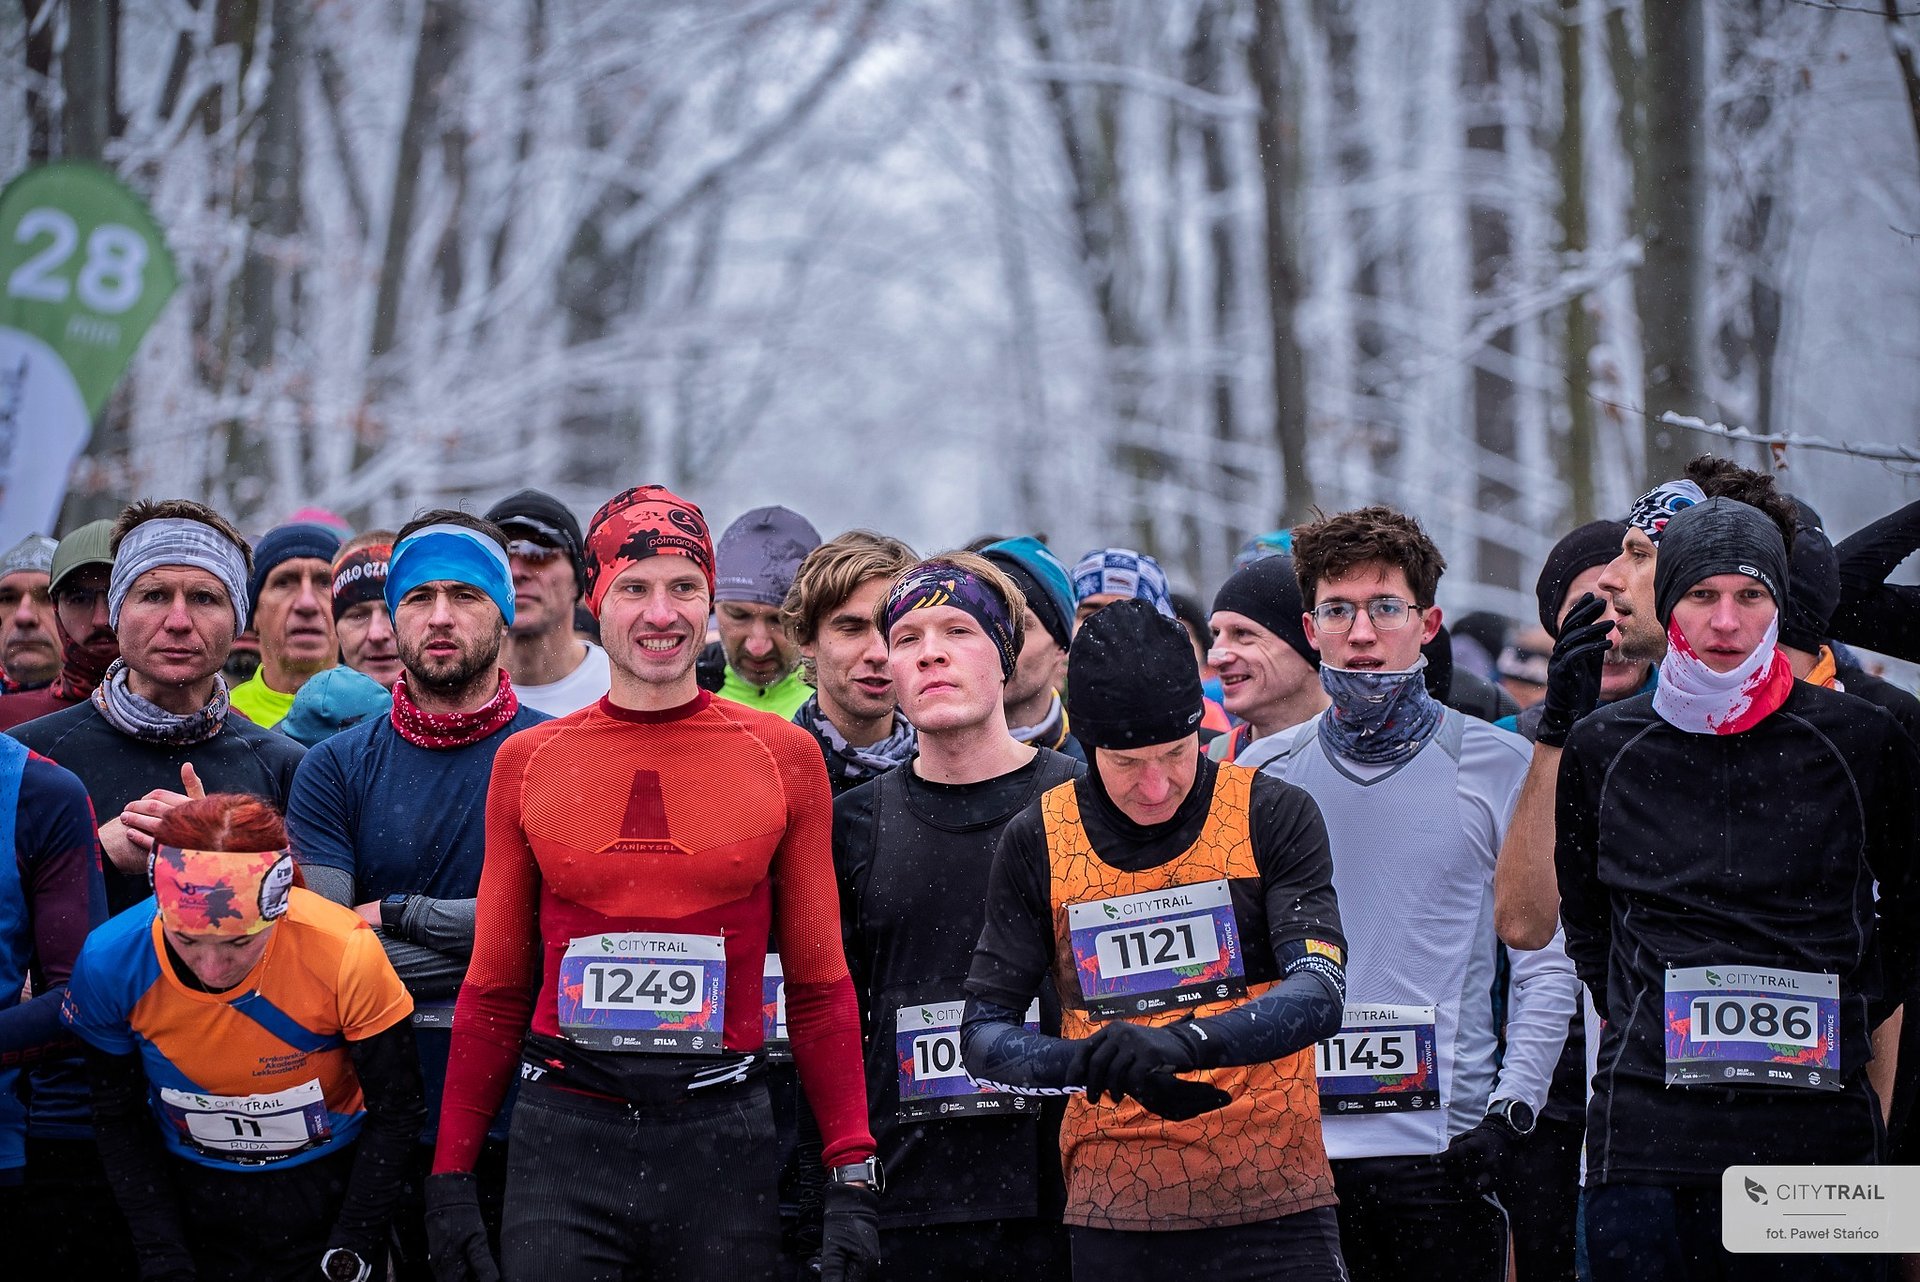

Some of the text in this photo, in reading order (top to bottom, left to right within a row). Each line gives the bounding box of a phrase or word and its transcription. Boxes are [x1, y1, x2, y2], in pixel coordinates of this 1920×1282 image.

[7, 206, 149, 315] 28
[1111, 923, 1196, 970] 1121
[1223, 921, 1236, 960] KATOWICE
[589, 967, 696, 1006] 1249
[711, 977, 719, 1014] KATOWICE
[1178, 991, 1202, 1002] SILVA
[1693, 1000, 1812, 1040] 1086
[654, 1038, 677, 1046] SILVA
[915, 1036, 965, 1074] 10
[1317, 1036, 1405, 1071] 1145
[1768, 1070, 1793, 1079] SILVA
[976, 1100, 1000, 1109] SILVA
[1374, 1100, 1398, 1108] SILVA
[225, 1116, 262, 1138] 11
[230, 1141, 269, 1150] RUDA
